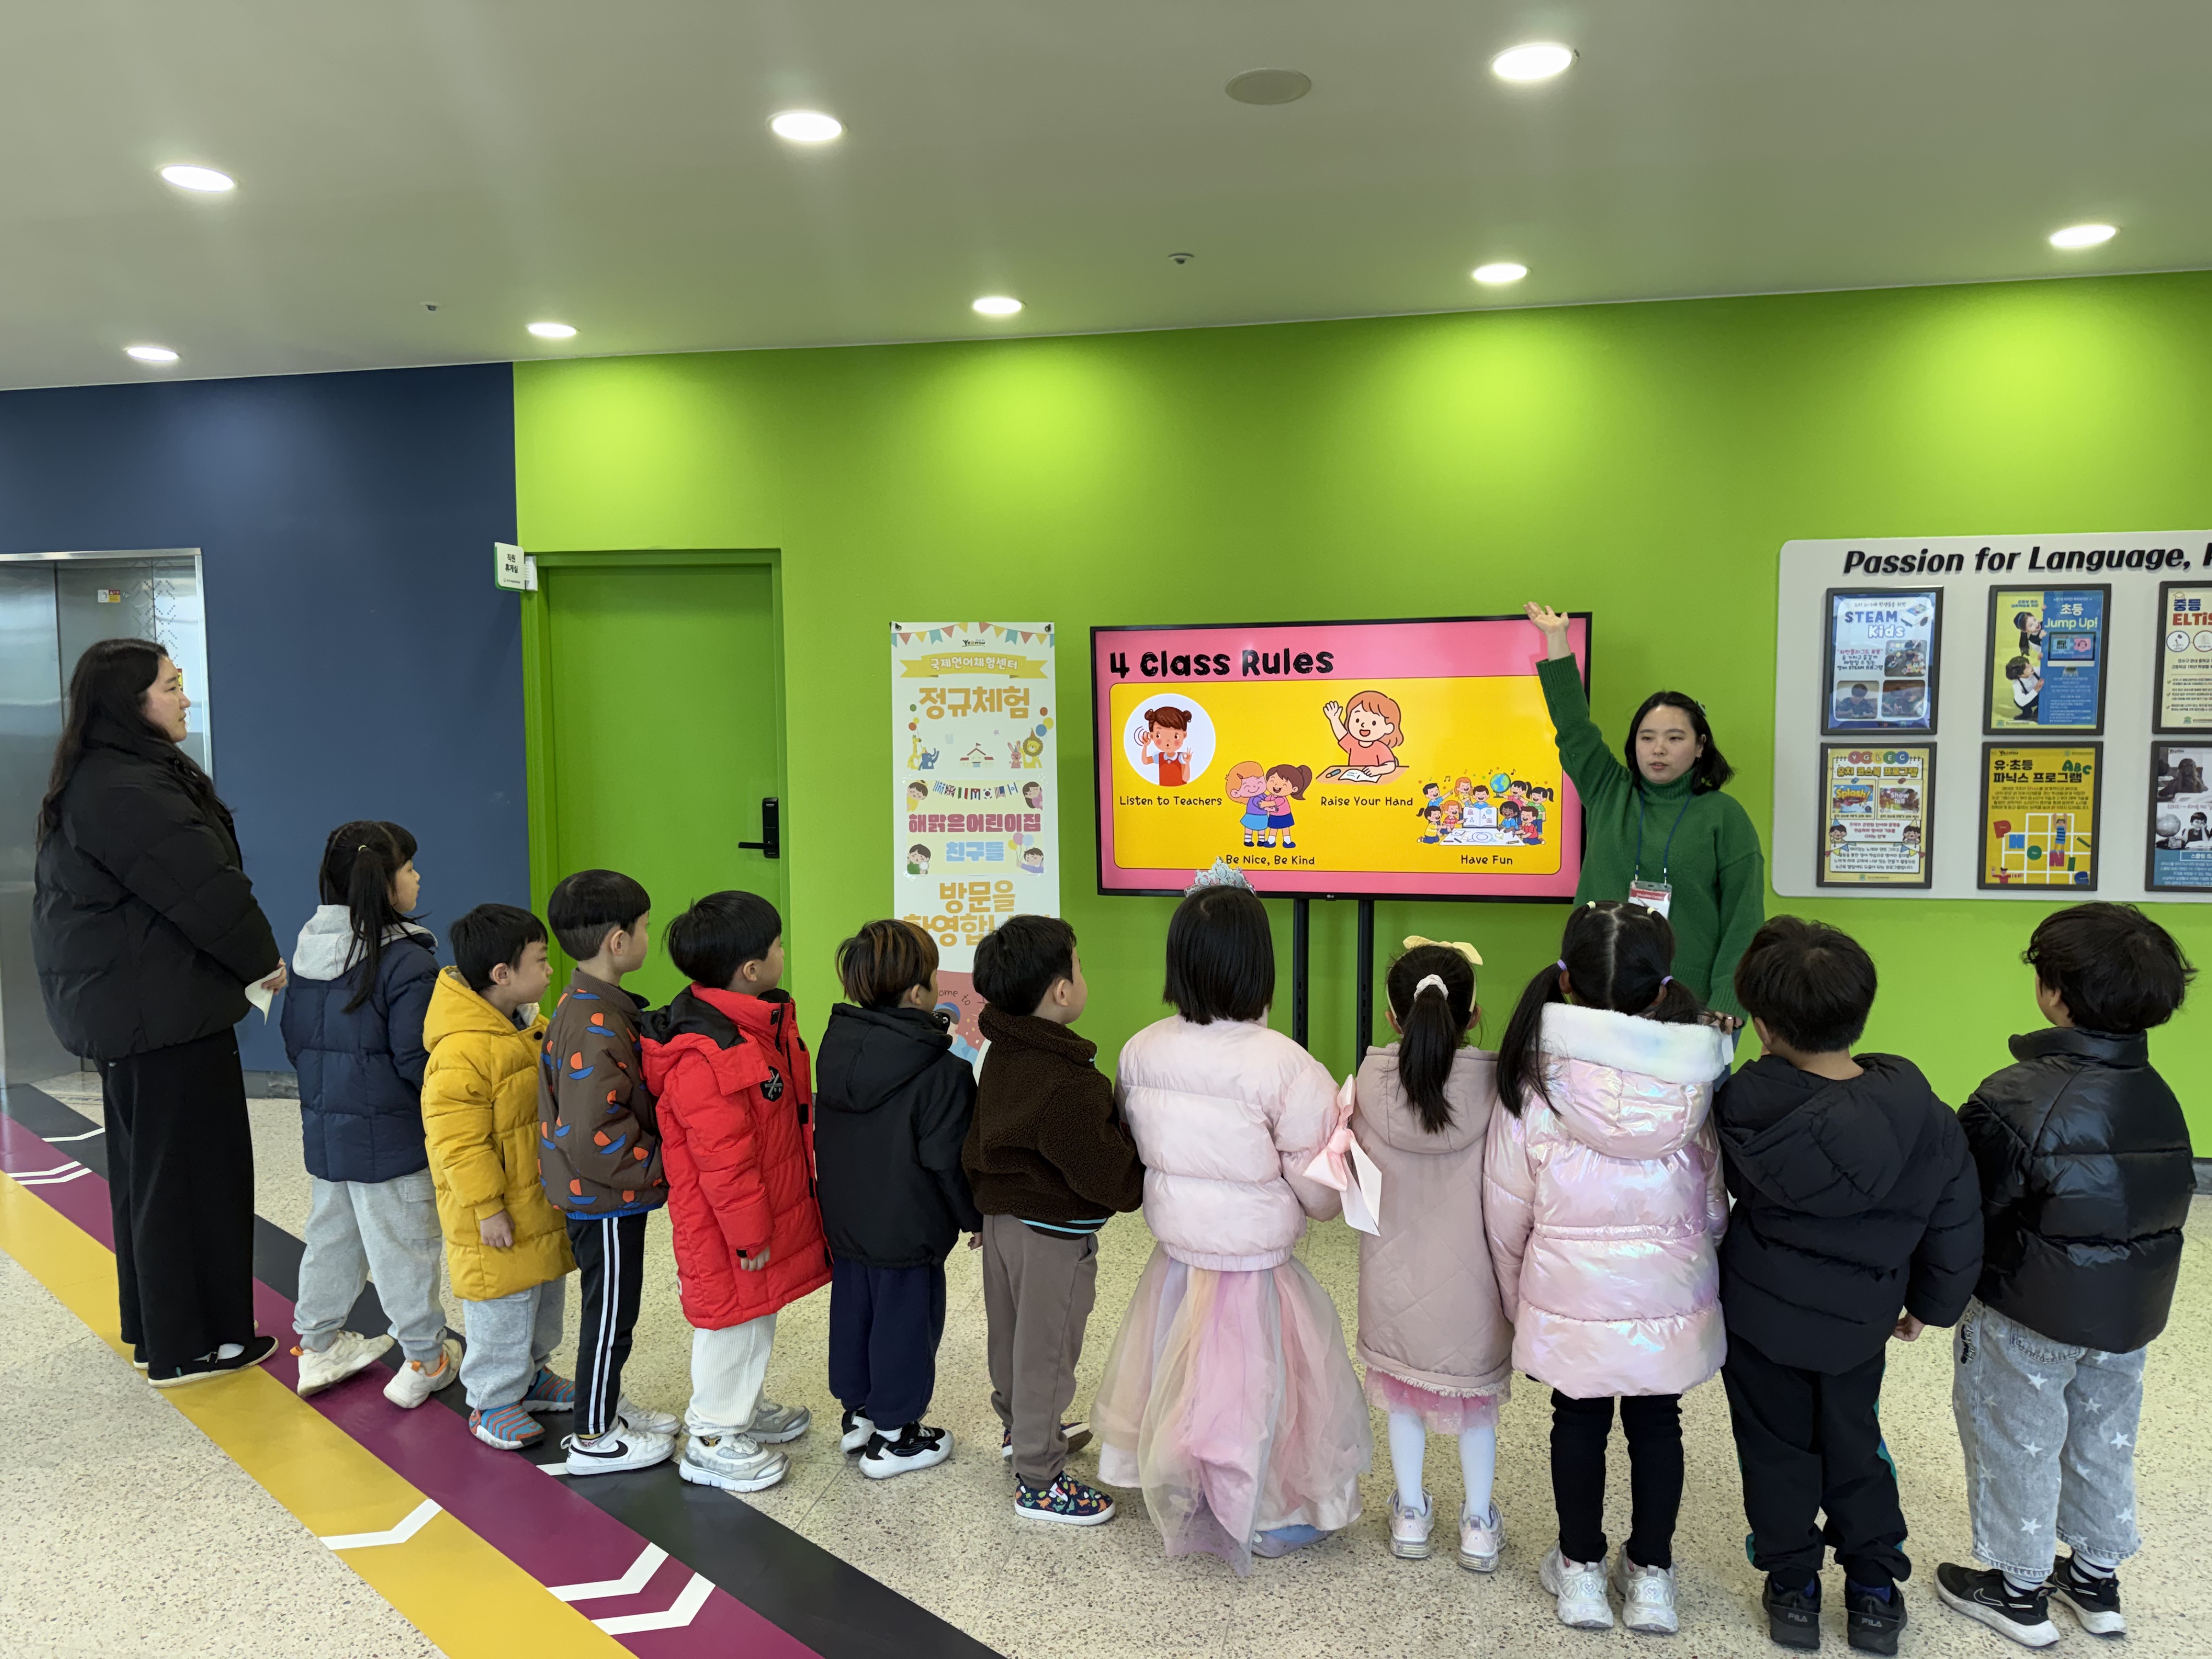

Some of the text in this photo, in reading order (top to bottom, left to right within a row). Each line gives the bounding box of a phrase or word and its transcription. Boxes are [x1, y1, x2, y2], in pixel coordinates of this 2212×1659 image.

[1843, 549, 1964, 574] Passion
[1975, 547, 2021, 571] for
[2028, 546, 2191, 571] Language,
[2060, 603, 2084, 616] 초등
[2174, 599, 2201, 611] 중등
[1844, 611, 1898, 623] STEAM
[2044, 617, 2098, 630] Jump Up!
[1868, 624, 1905, 638] Kids
[930, 657, 1018, 670] 국제언어체험센터
[1110, 647, 1334, 679] 4 Class Rules
[919, 686, 1030, 719] 정규체험
[1883, 766, 1918, 777] 프로그램
[2062, 759, 2092, 775] ABC
[1993, 772, 2082, 783] 파닉스 프로그램
[1836, 787, 1871, 799] Splash!
[1120, 795, 1222, 806] Listen to Teachers
[1321, 796, 1413, 806] Raise Your Hand
[909, 814, 1041, 833] 해맑은어린이집
[946, 841, 1004, 861] 친구들
[1226, 855, 1314, 866] Be Nice, Be Kind
[1461, 855, 1513, 865] Have Fun
[939, 880, 1015, 913] 방문을
[961, 994, 970, 1006] to
[1788, 1613, 1808, 1622] FILA
[1861, 1618, 1882, 1627] FILA
